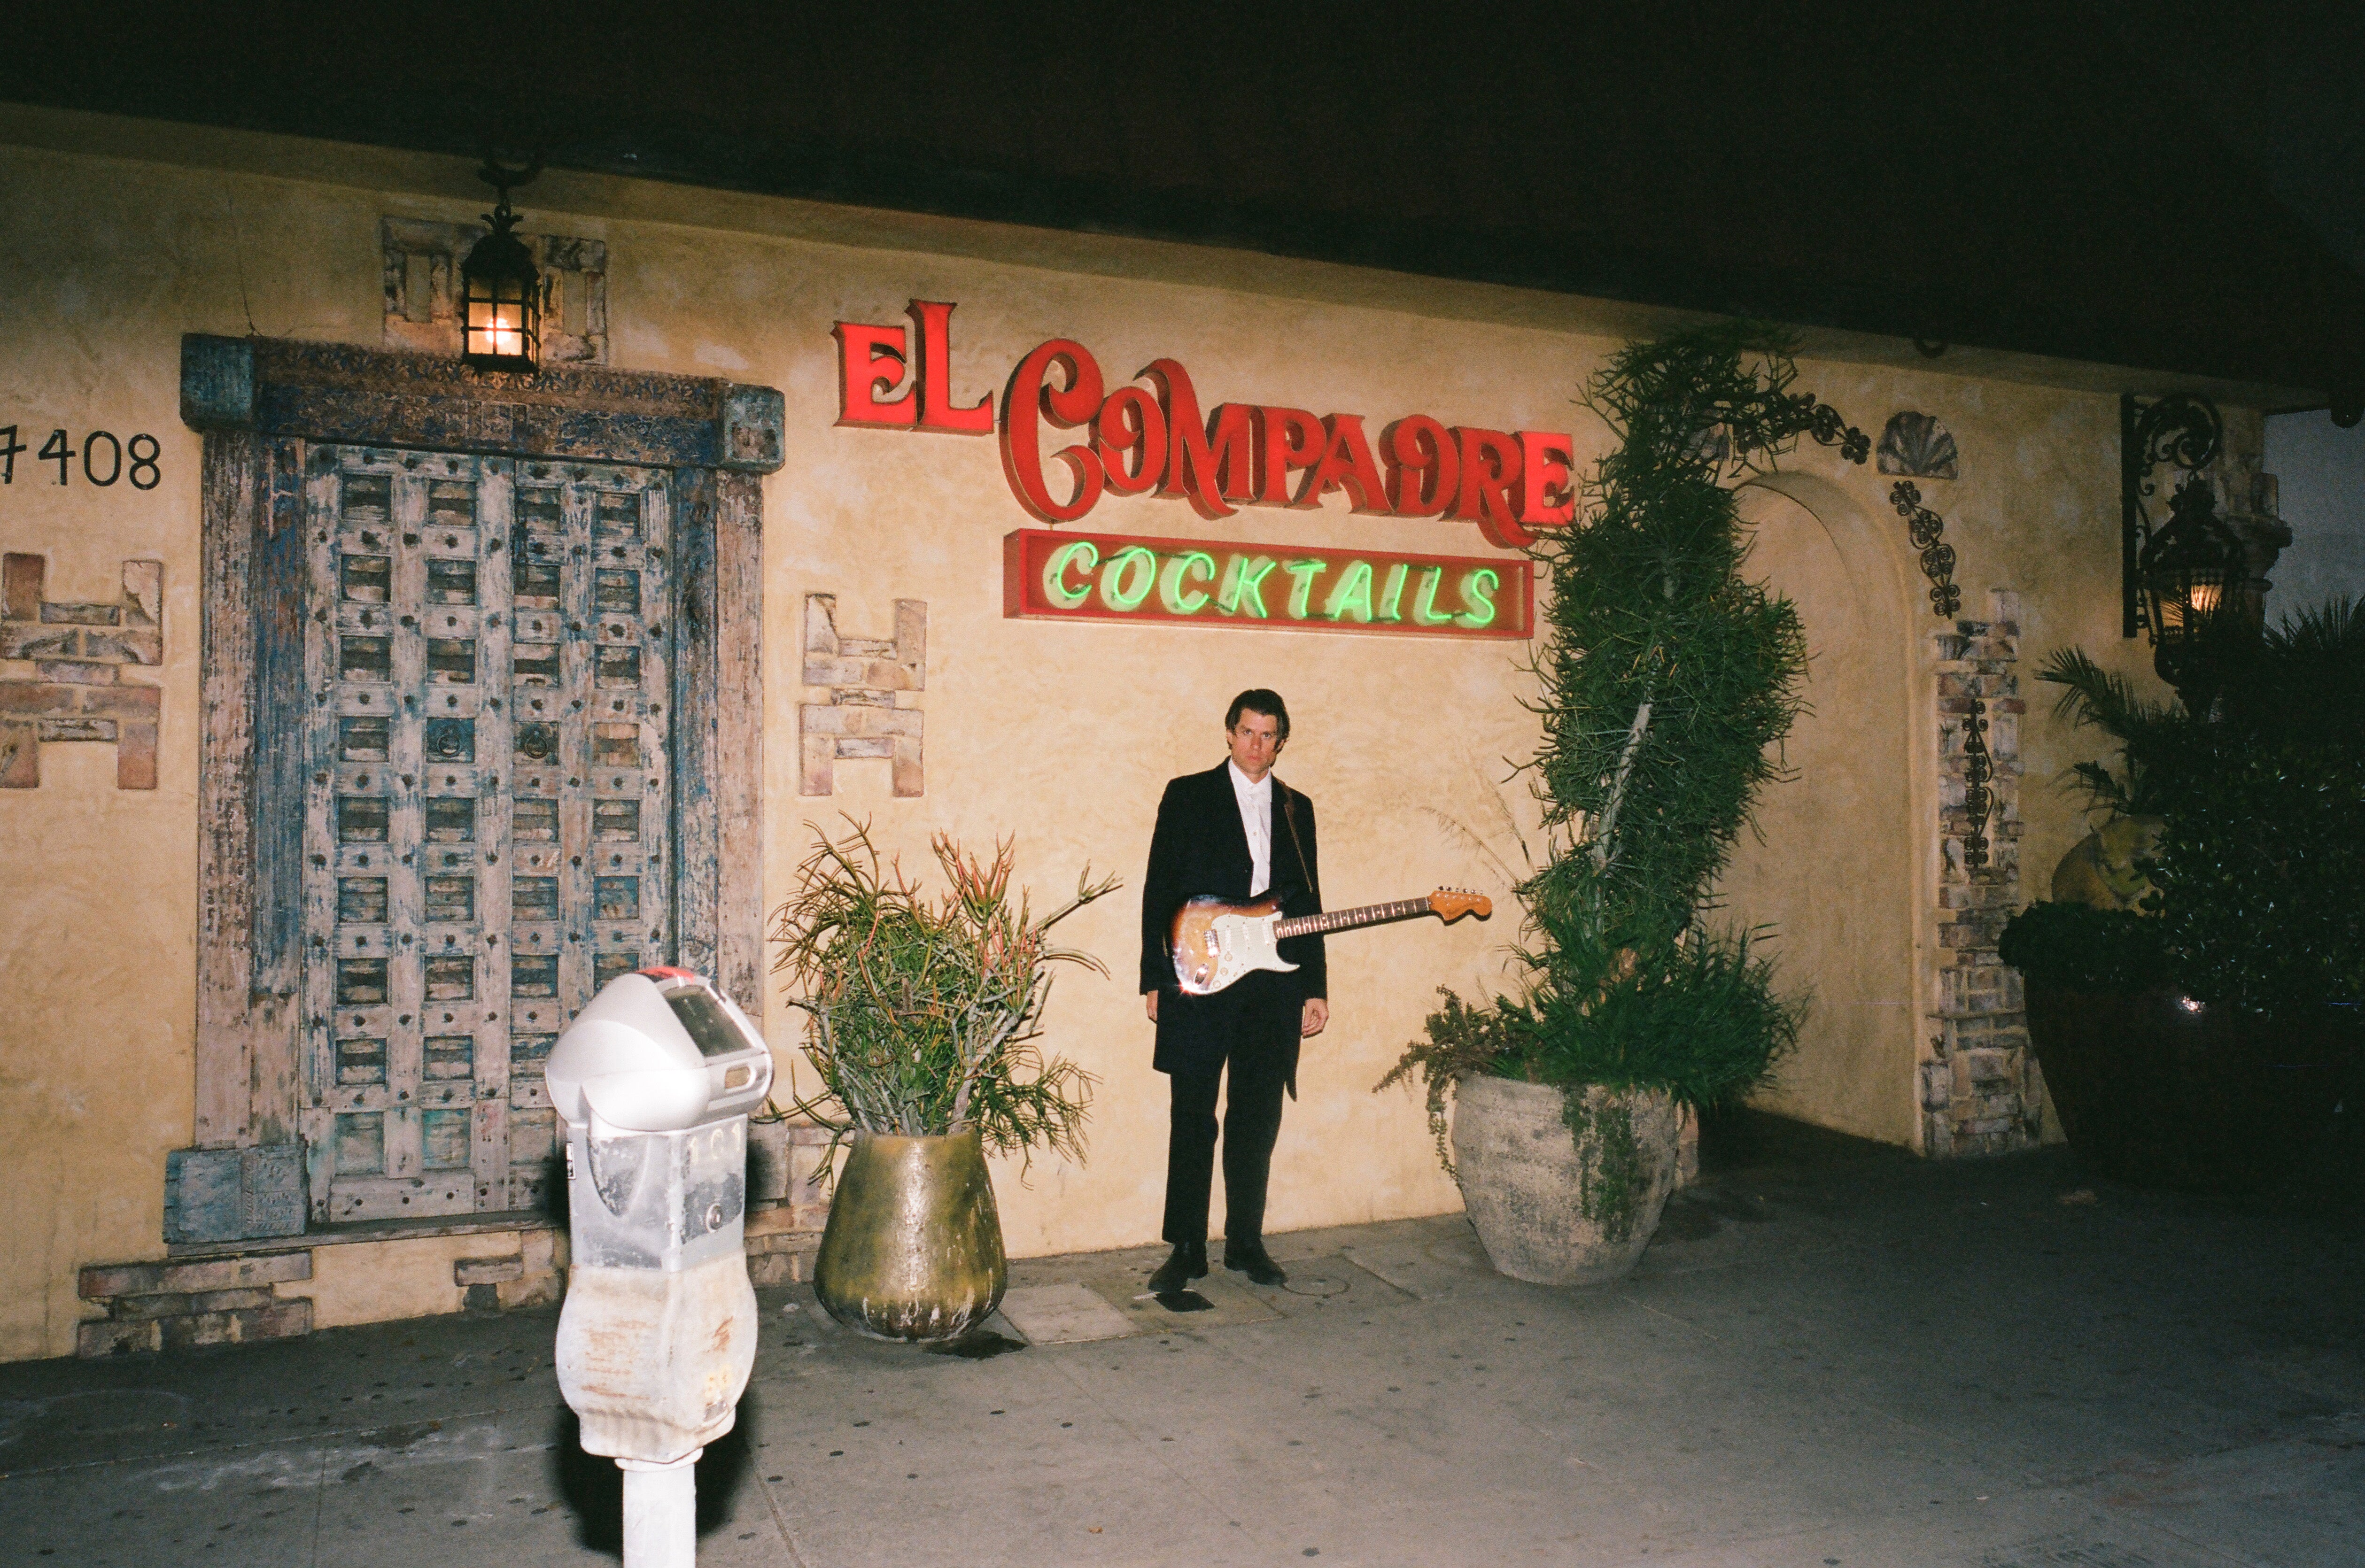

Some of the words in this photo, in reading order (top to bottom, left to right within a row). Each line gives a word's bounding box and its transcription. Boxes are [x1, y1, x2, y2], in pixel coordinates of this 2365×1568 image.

[0, 424, 161, 490] 7408
[830, 298, 994, 437] EL
[999, 338, 1575, 549] COMPADRE
[1043, 541, 1499, 628] COCKTAILS
